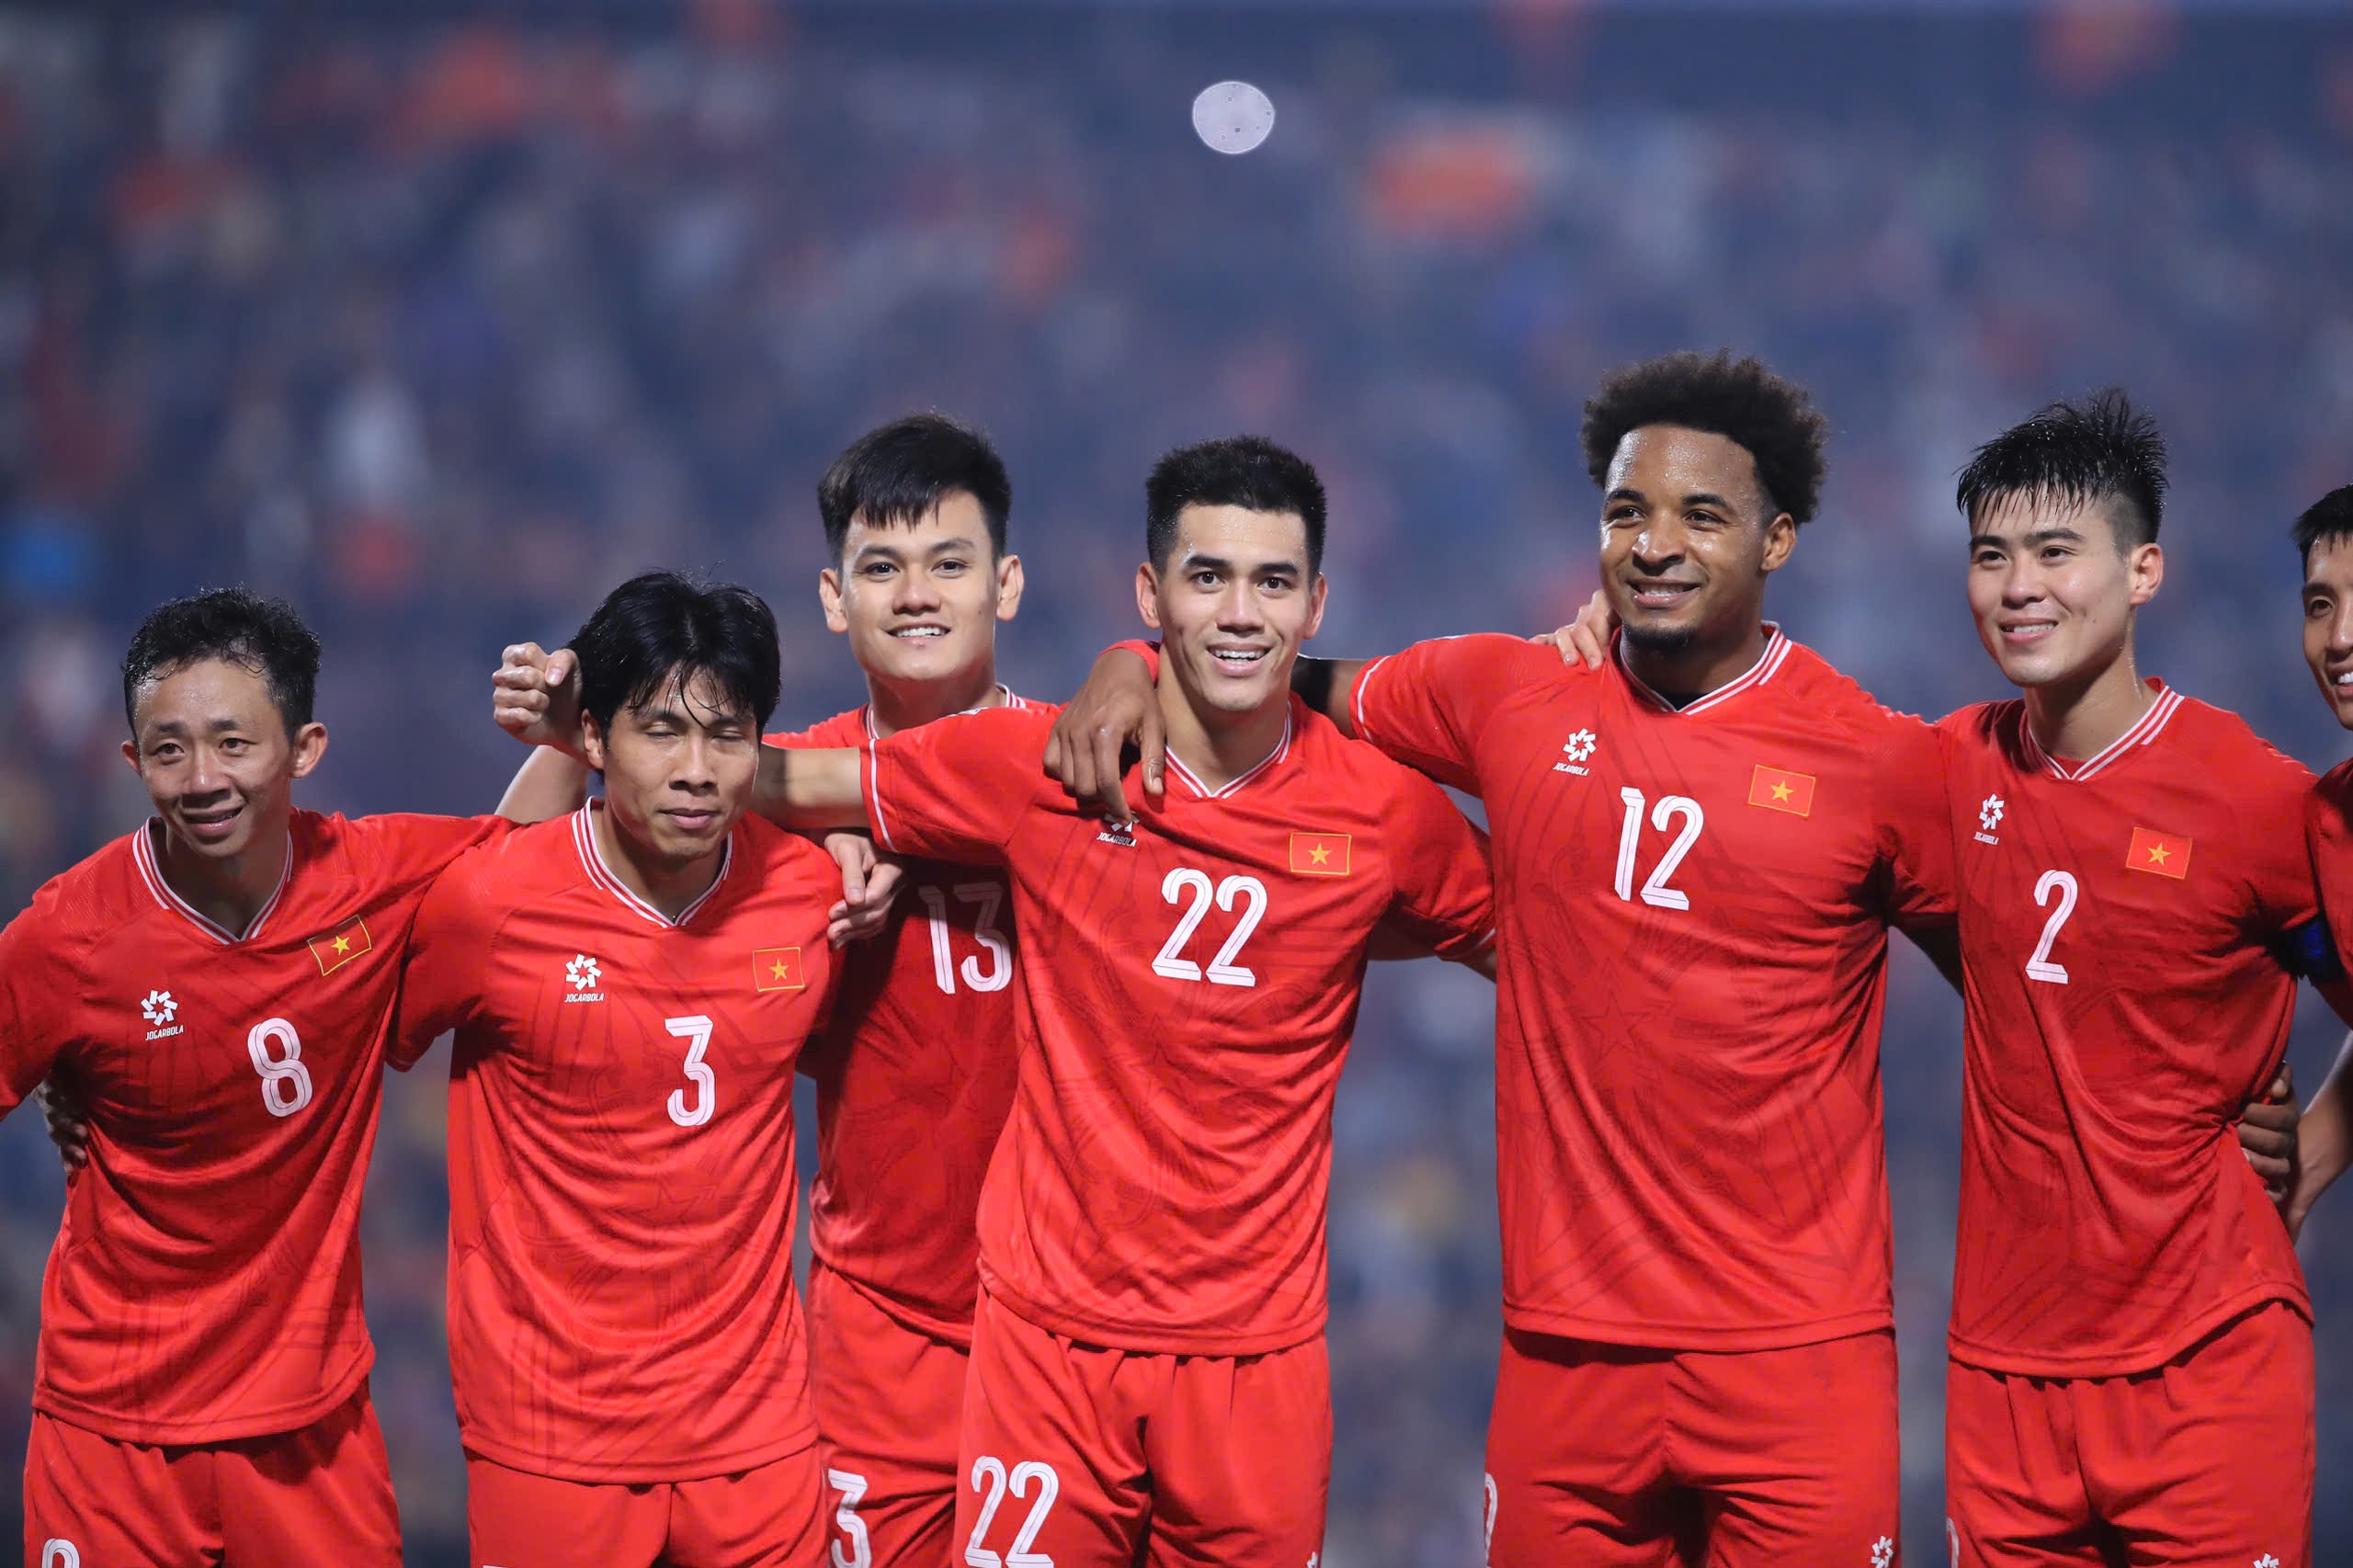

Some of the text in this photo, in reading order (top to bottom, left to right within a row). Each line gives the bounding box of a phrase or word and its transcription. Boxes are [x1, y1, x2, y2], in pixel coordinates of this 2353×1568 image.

[1614, 786, 1705, 911] 12
[919, 881, 1012, 994] 13
[1151, 867, 1268, 988] 22
[2025, 869, 2078, 984] 2
[145, 1025, 184, 1040] JOGARBOLA
[246, 1017, 313, 1118] 8
[664, 1014, 716, 1127] 3
[964, 1455, 1060, 1568] 22
